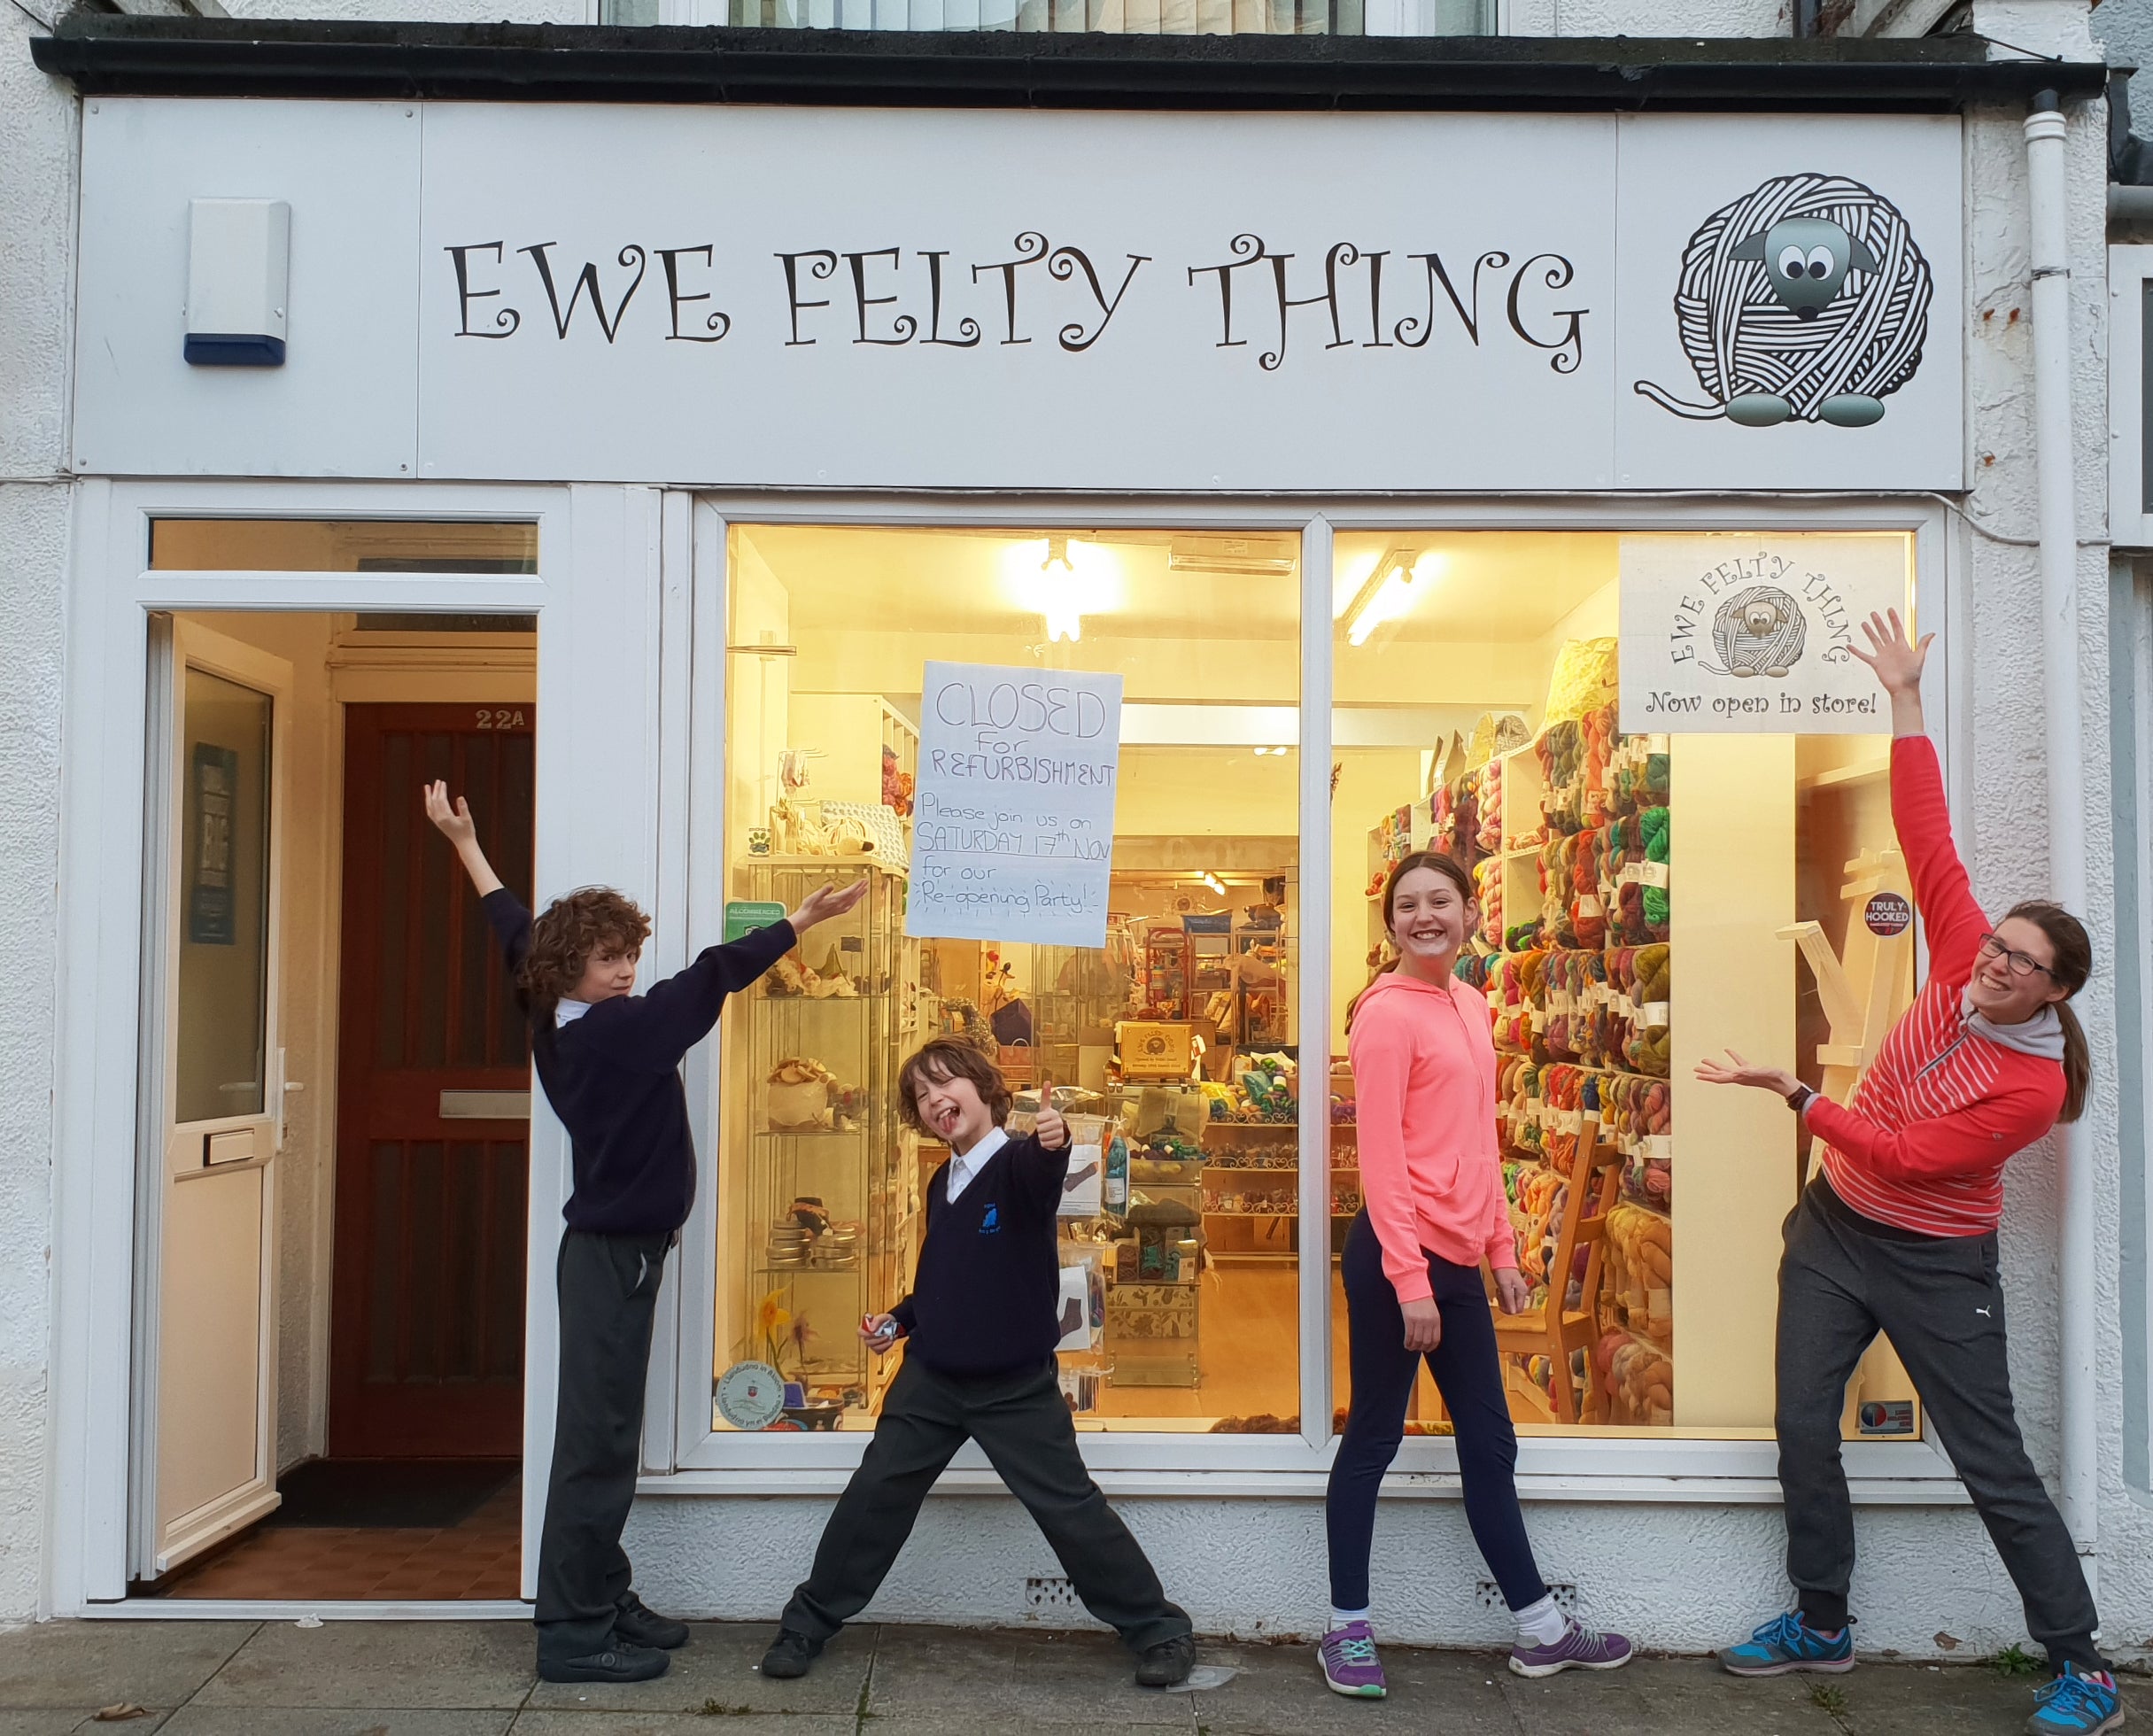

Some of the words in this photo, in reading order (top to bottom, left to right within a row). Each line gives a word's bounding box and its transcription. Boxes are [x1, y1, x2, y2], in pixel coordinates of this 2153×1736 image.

[444, 241, 731, 344] EWE
[773, 231, 1152, 352] FELTY
[1188, 233, 1590, 374] THING
[1670, 595, 1705, 664] EWE
[1700, 551, 1795, 595] FELTY
[1801, 571, 1851, 663] THING
[475, 709, 525, 729] 22A
[936, 683, 1105, 738] CLOSED
[1646, 691, 1701, 713] Now
[1712, 695, 1770, 718] open
[1779, 692, 1801, 714] in
[1812, 693, 1877, 714] store!
[932, 748, 1114, 787] REFURBISHMENT
[921, 792, 985, 820] Please
[988, 805, 1023, 830] join
[1035, 814, 1057, 828] us
[1069, 818, 1091, 830] on
[917, 821, 1022, 853] SATURDAY
[922, 856, 951, 877] for
[961, 866, 996, 880] our
[921, 880, 1030, 913] Re-opening
[1034, 884, 1088, 913] Party!
[1870, 902, 1904, 911] TRULY
[1866, 912, 1909, 922] HOOKED
